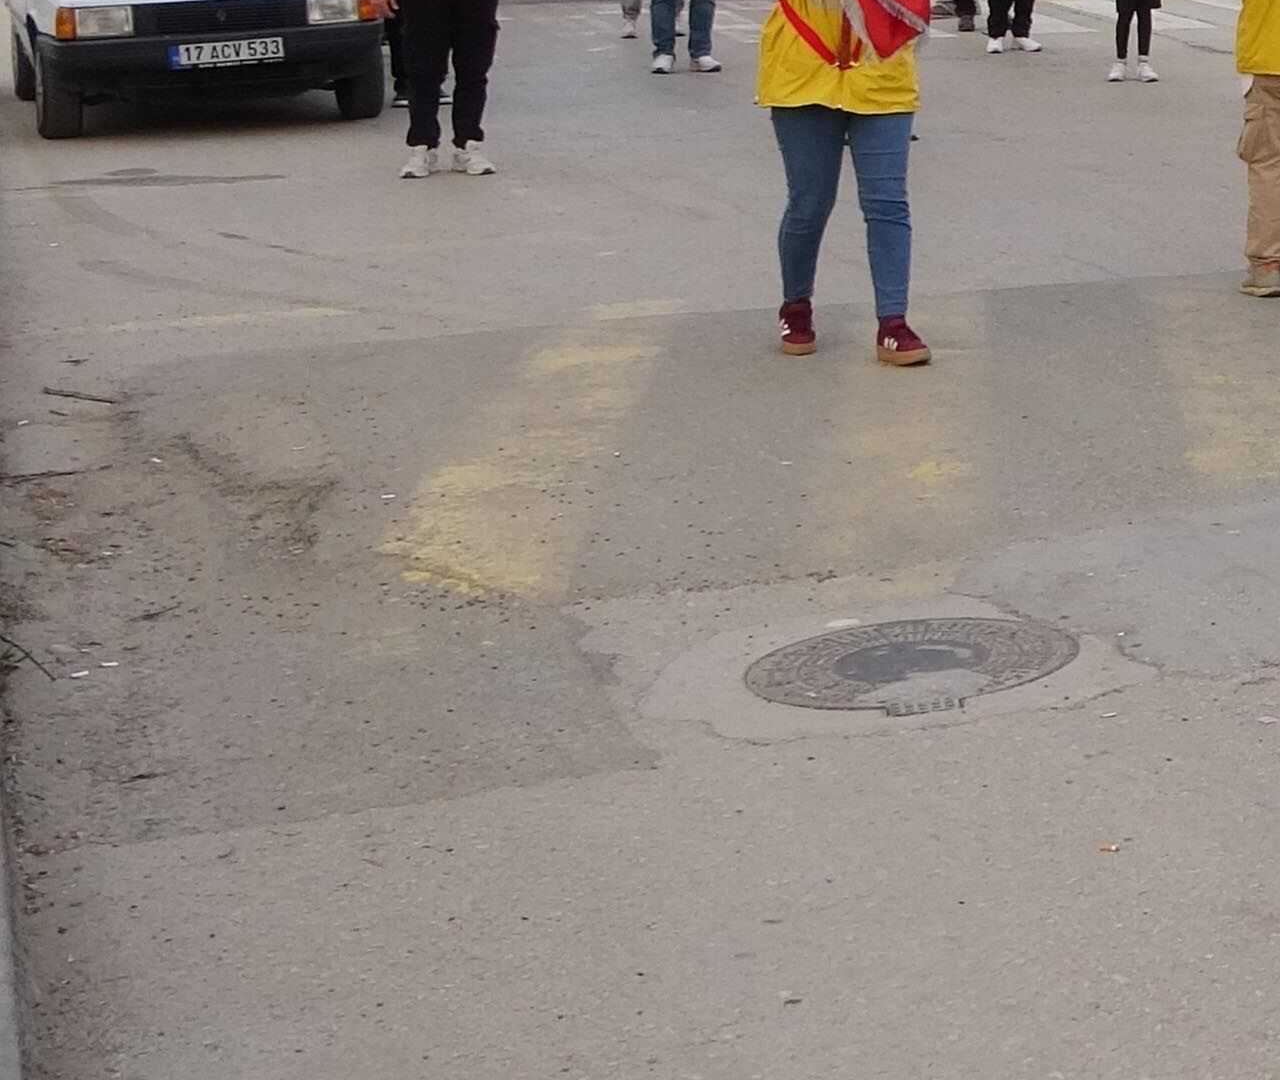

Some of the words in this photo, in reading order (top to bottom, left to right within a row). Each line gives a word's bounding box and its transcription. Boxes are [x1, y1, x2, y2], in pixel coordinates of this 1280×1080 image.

[184, 46, 204, 62] 17
[210, 42, 242, 60] ACV
[247, 40, 280, 57] 533
